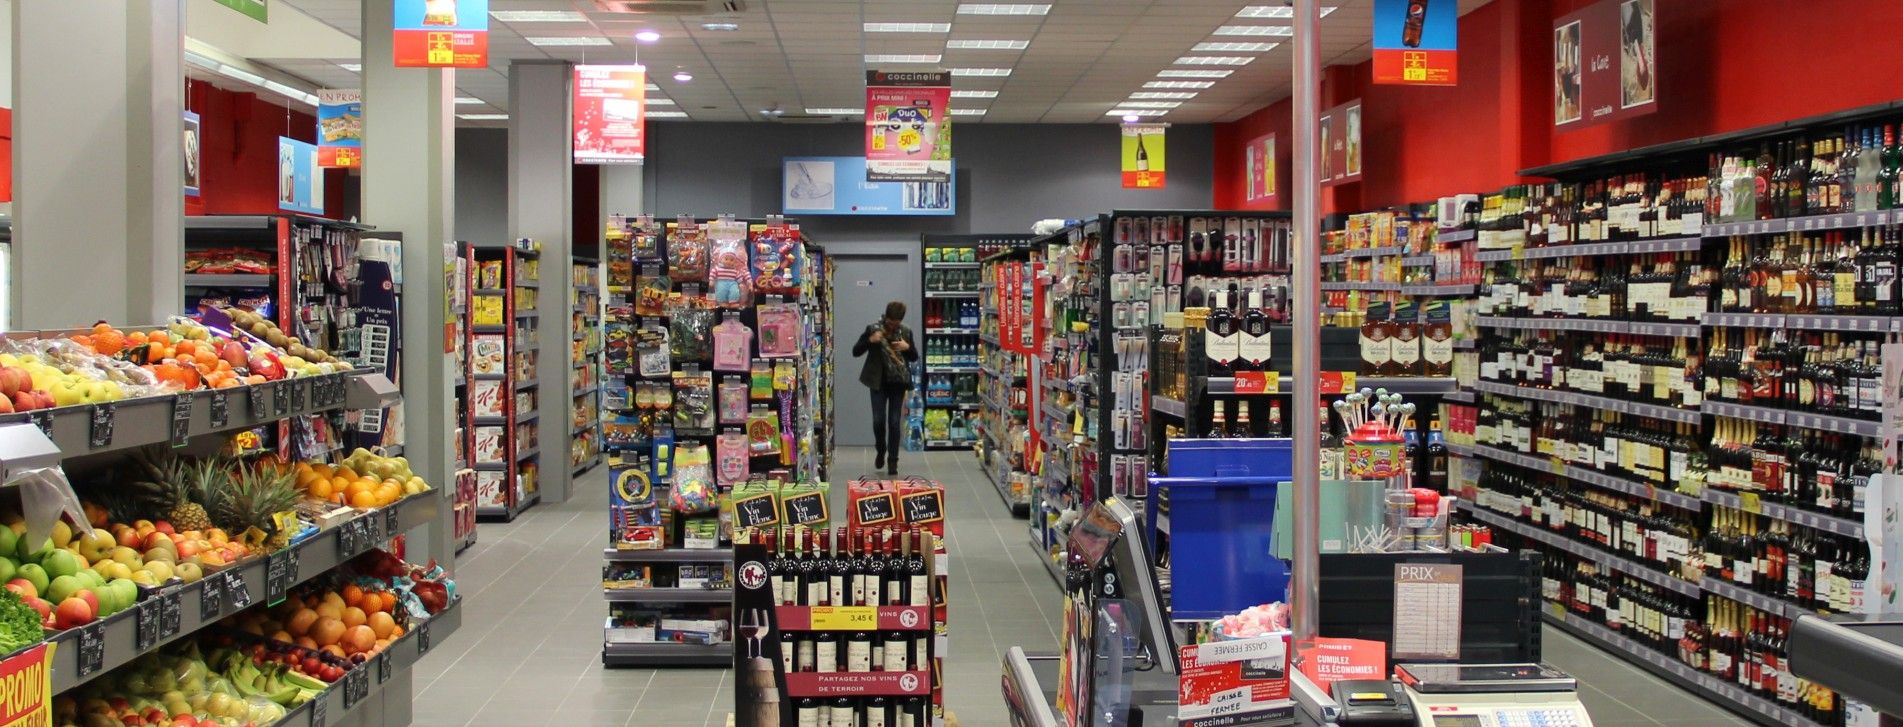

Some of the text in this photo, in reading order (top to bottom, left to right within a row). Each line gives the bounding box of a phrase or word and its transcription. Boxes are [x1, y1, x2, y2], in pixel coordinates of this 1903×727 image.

[887, 72, 941, 81] coccinelle
[336, 93, 361, 101] PROM
[744, 504, 760, 515] Vin
[793, 503, 809, 514] Vin
[865, 503, 879, 513] Vin
[911, 502, 927, 511] Vin
[864, 511, 888, 522] Rouge
[911, 509, 937, 521] Rouge
[1400, 566, 1434, 580] PRIX
[1244, 641, 1268, 653] CAISSE
[1182, 659, 1194, 669] LES
[1317, 655, 1350, 665] CUMULEZ
[1317, 664, 1331, 673] LES
[1332, 663, 1373, 674] ÉCONOMIES
[1217, 690, 1243, 703] CAISSE
[1193, 717, 1234, 727] coccinelle
